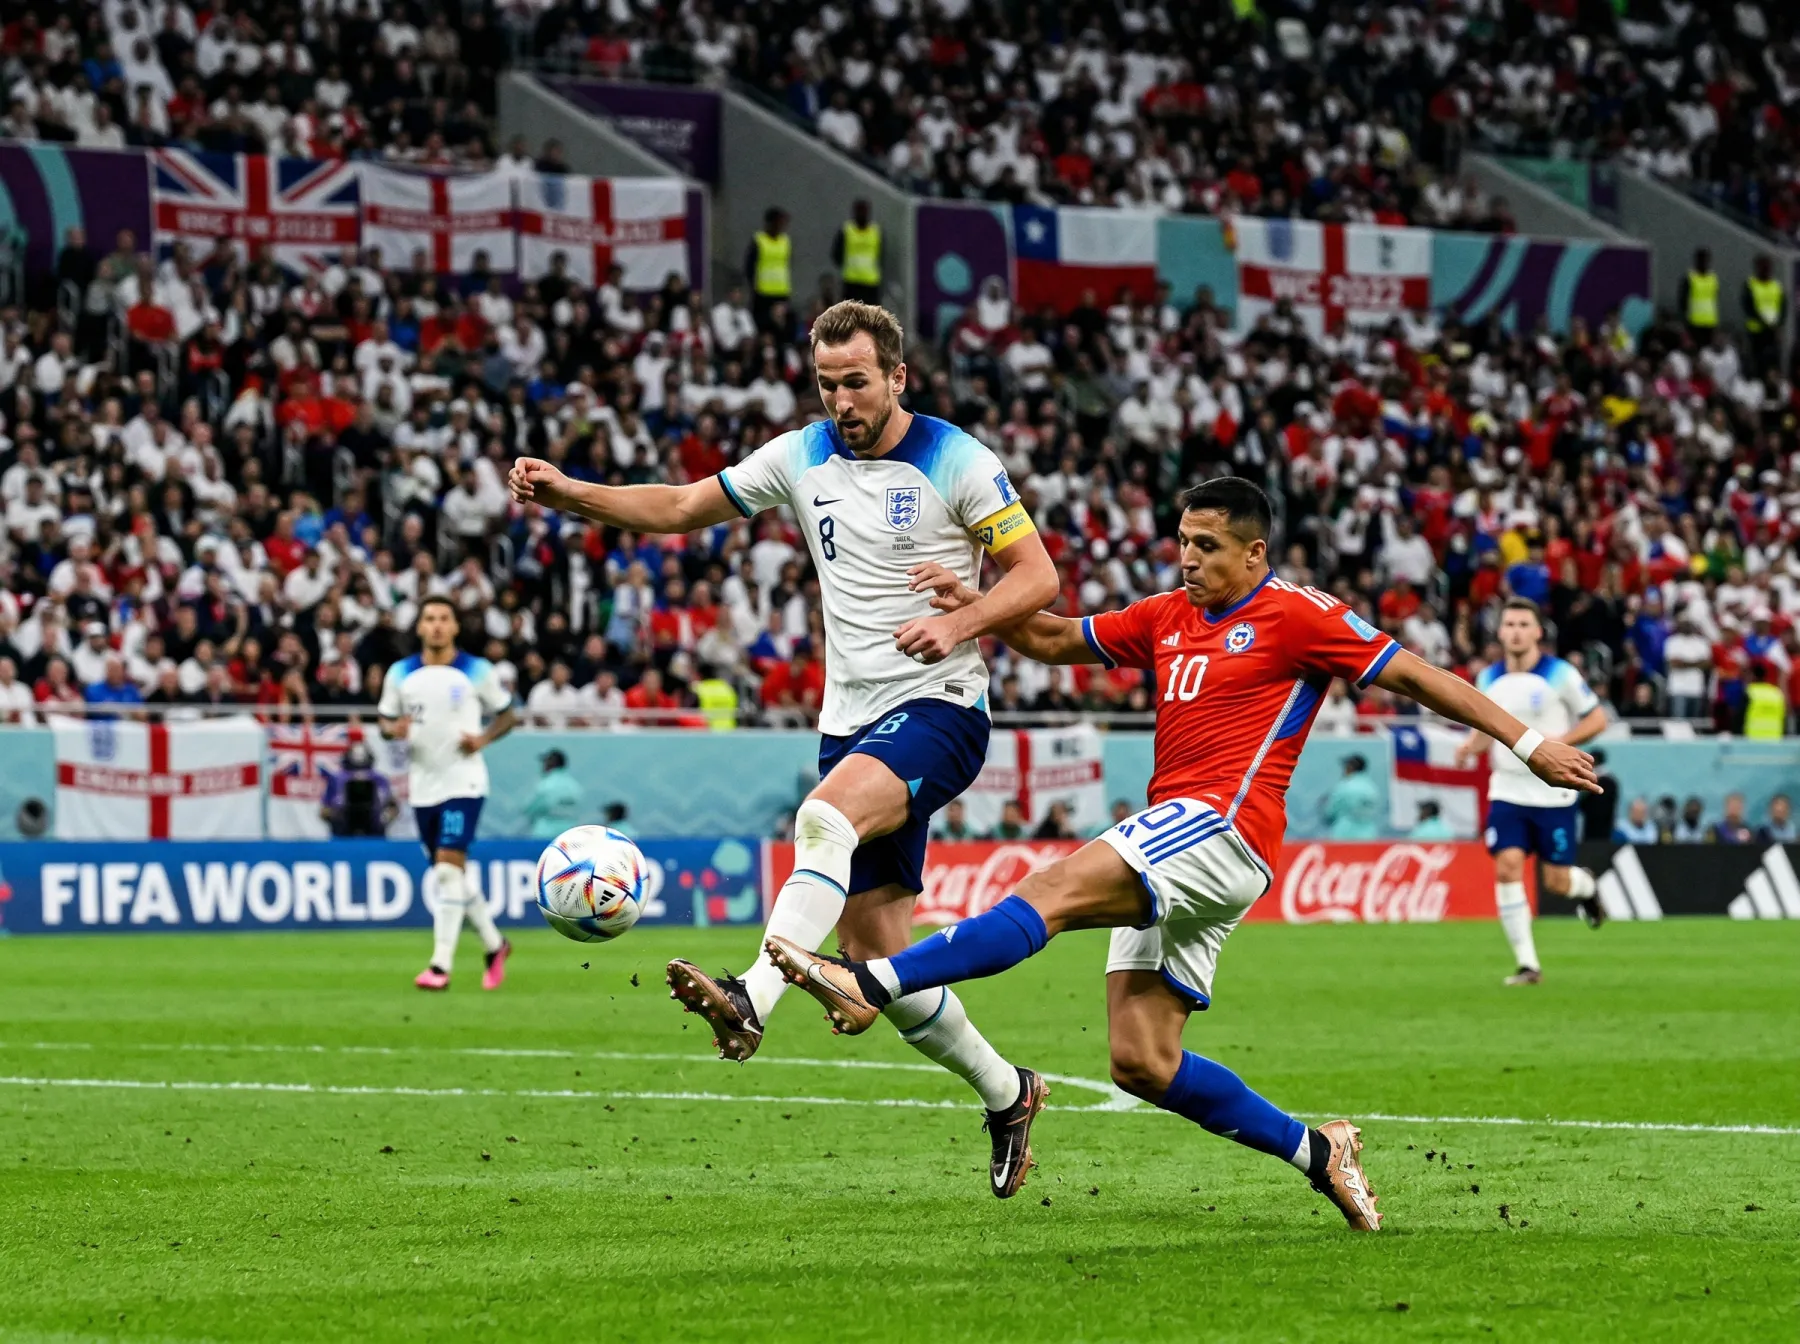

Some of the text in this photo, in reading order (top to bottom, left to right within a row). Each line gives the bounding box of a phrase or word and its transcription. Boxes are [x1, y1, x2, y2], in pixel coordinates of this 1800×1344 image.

[819, 516, 836, 562] 8
[1163, 653, 1210, 702] 10
[874, 712, 909, 735] 8
[40, 862, 181, 925] FIFA
[182, 860, 414, 924] WORLD
